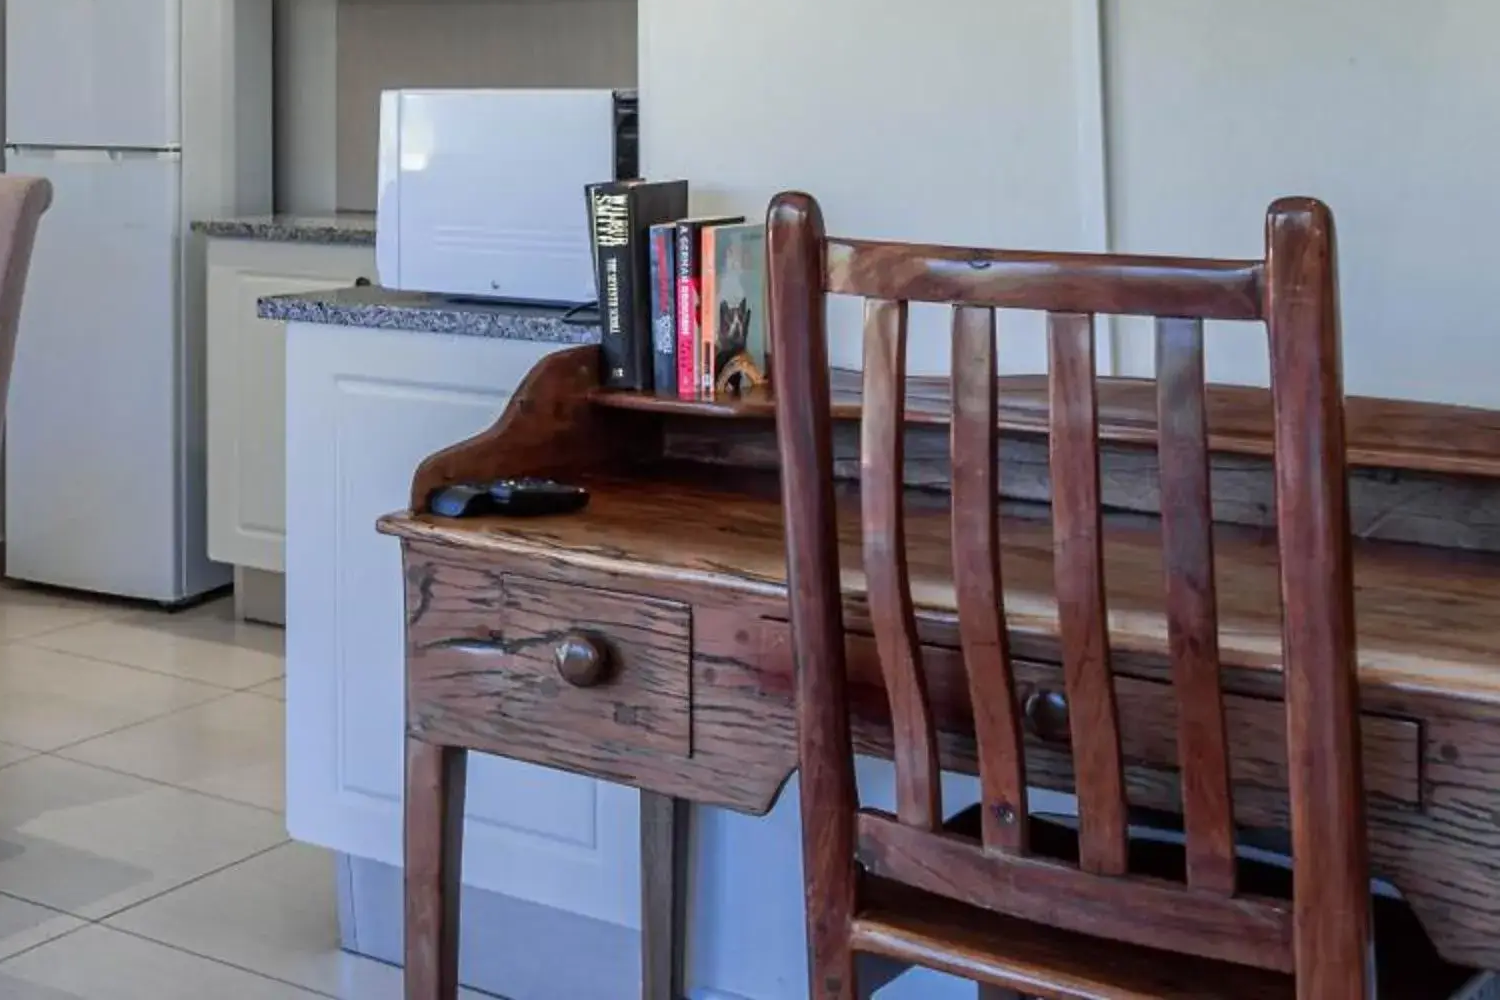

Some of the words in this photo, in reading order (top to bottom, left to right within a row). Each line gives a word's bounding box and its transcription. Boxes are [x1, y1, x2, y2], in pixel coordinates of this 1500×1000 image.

[595, 194, 613, 247] SMITH
[610, 193, 629, 246] WILBUR
[680, 225, 688, 234] A
[681, 236, 691, 283] GERMAN
